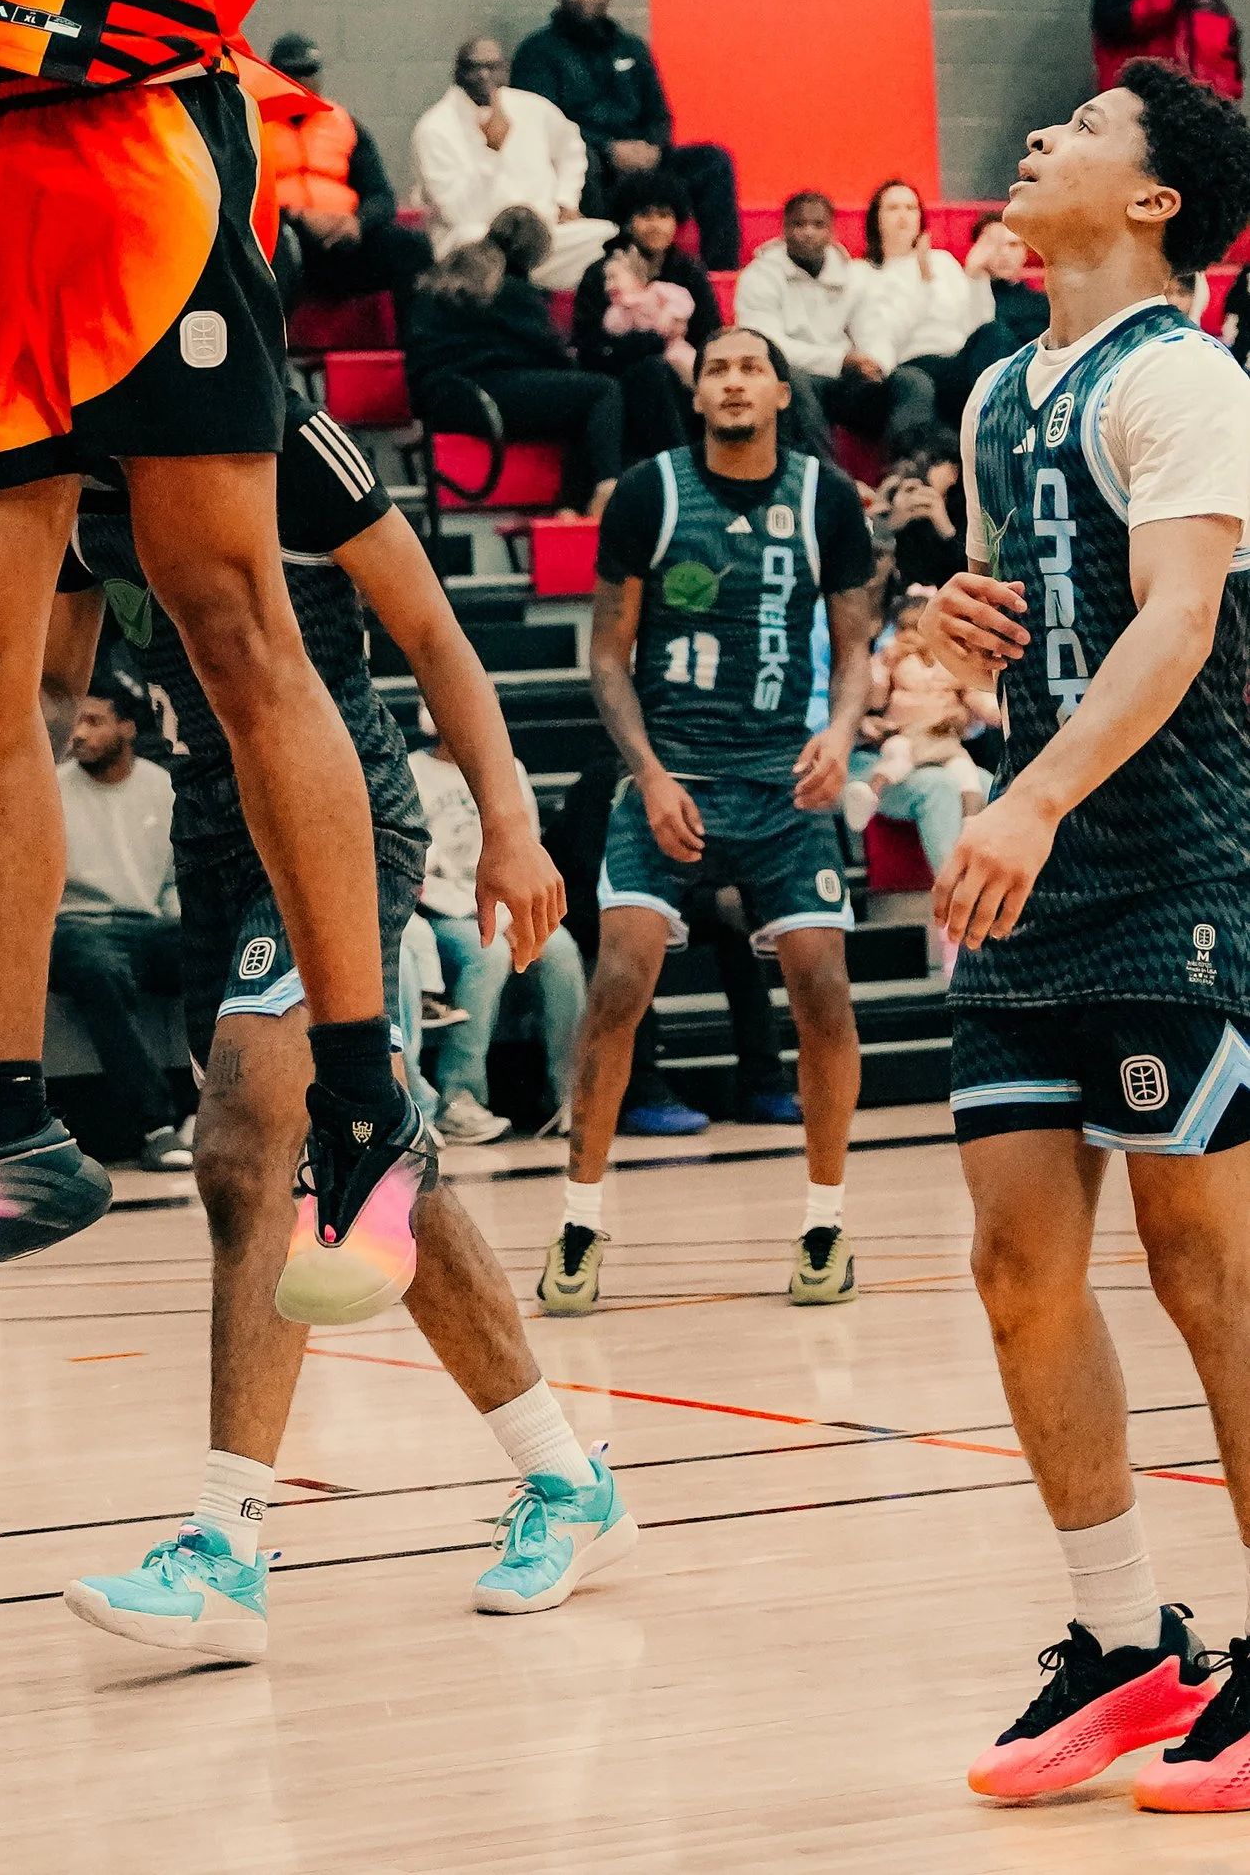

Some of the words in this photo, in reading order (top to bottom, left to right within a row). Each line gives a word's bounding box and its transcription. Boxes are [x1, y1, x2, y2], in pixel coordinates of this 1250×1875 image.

[24, 14, 37, 24] XL
[663, 631, 720, 691] 11
[1196, 950, 1210, 962] M
